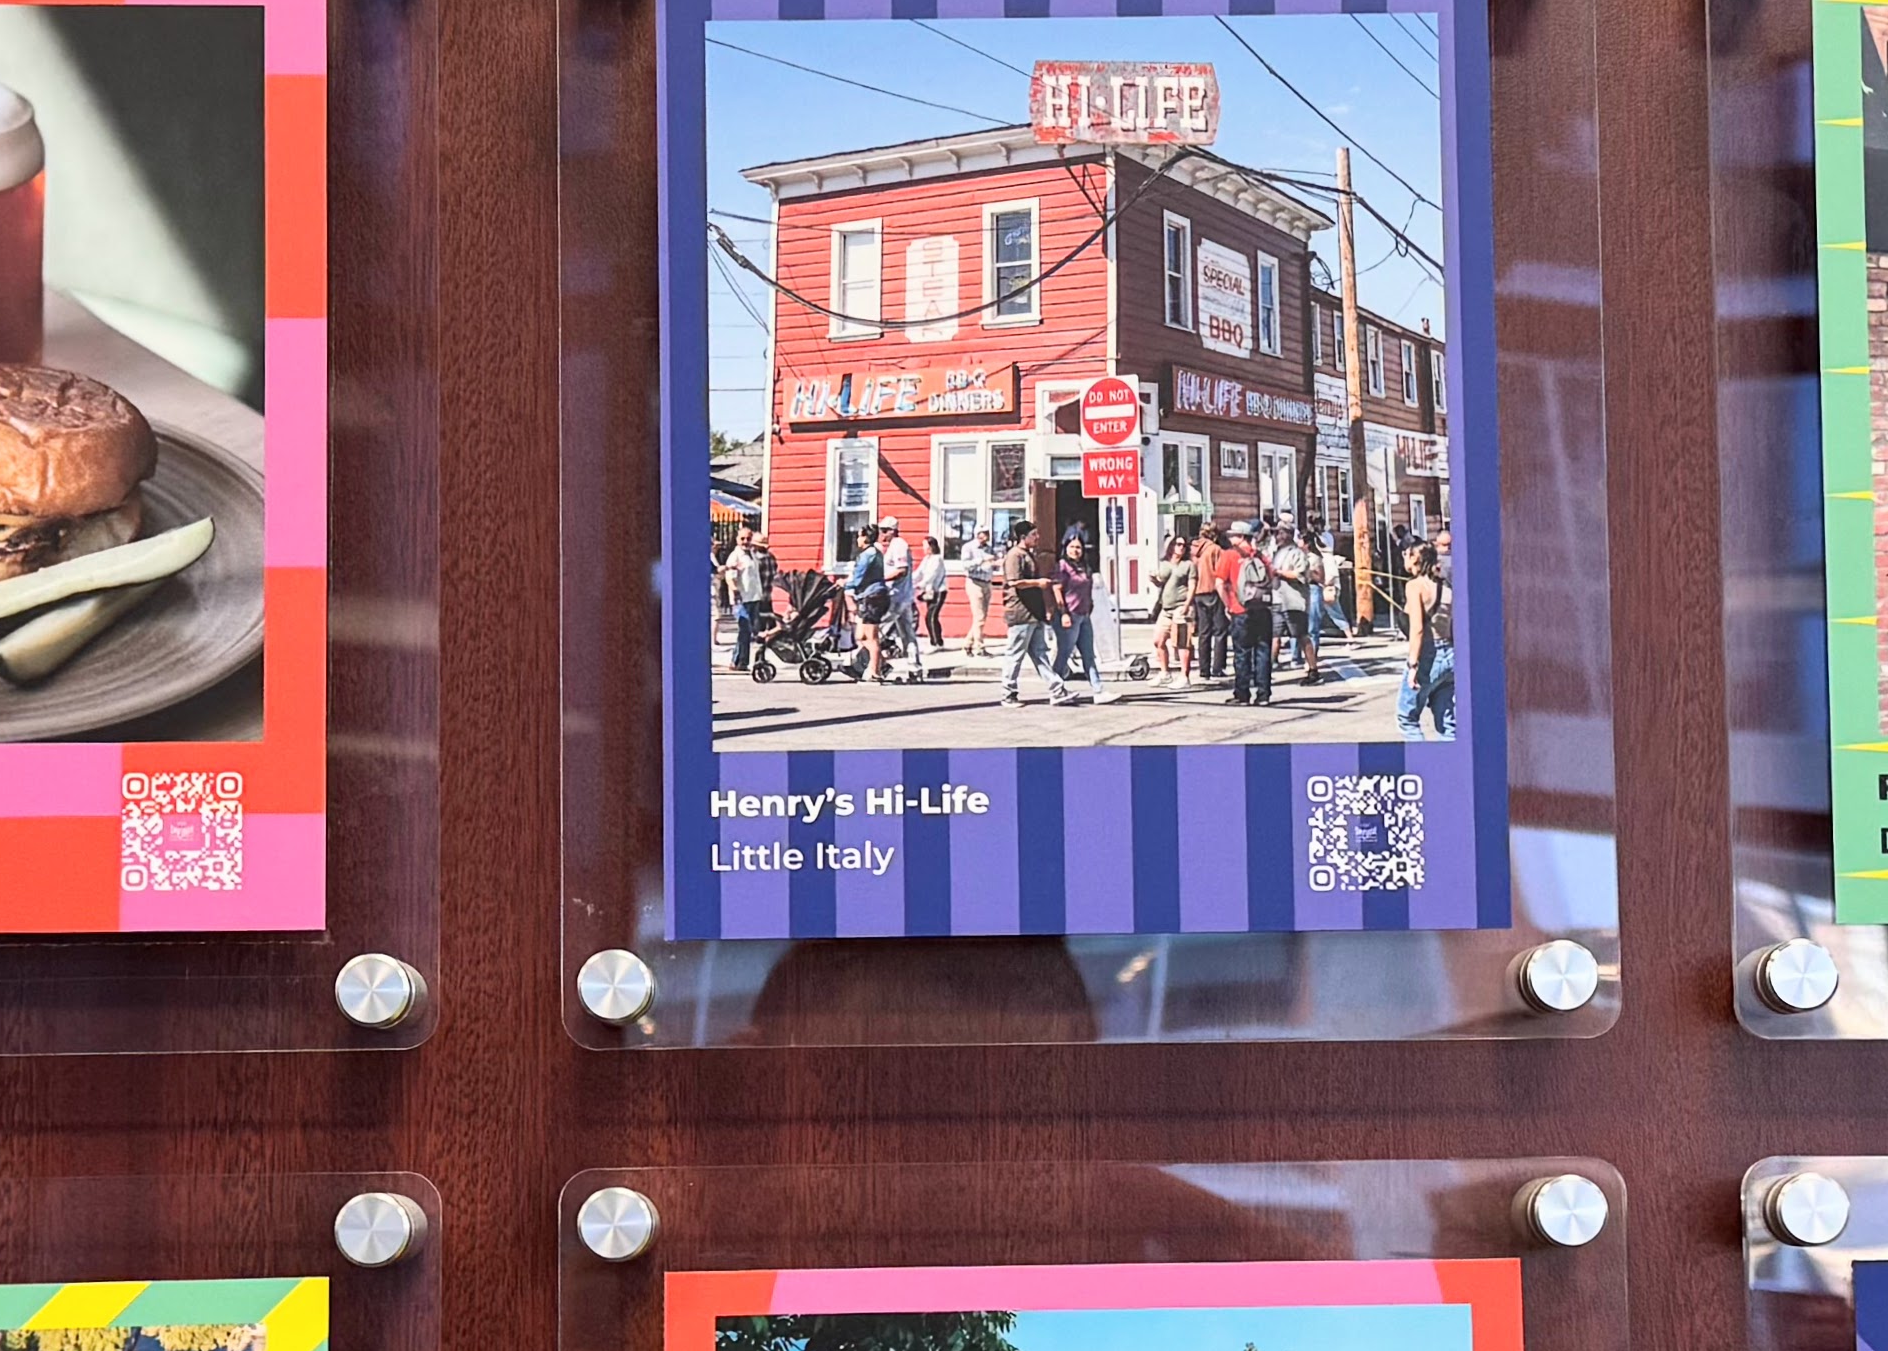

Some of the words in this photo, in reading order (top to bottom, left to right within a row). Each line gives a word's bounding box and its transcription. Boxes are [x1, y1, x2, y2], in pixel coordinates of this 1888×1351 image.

[1202, 264, 1246, 297] SPECIAL
[1209, 314, 1244, 349] BBQ
[927, 389, 1005, 413] DINNERS
[1088, 390, 1104, 404] DO
[1108, 388, 1130, 402] NOT
[1092, 420, 1128, 435] ENTER
[1088, 455, 1134, 472] WRONG
[1097, 473, 1125, 489] WAY
[865, 784, 990, 817] Hi-Life
[711, 842, 805, 873] Little
[815, 840, 895, 876] Italy
